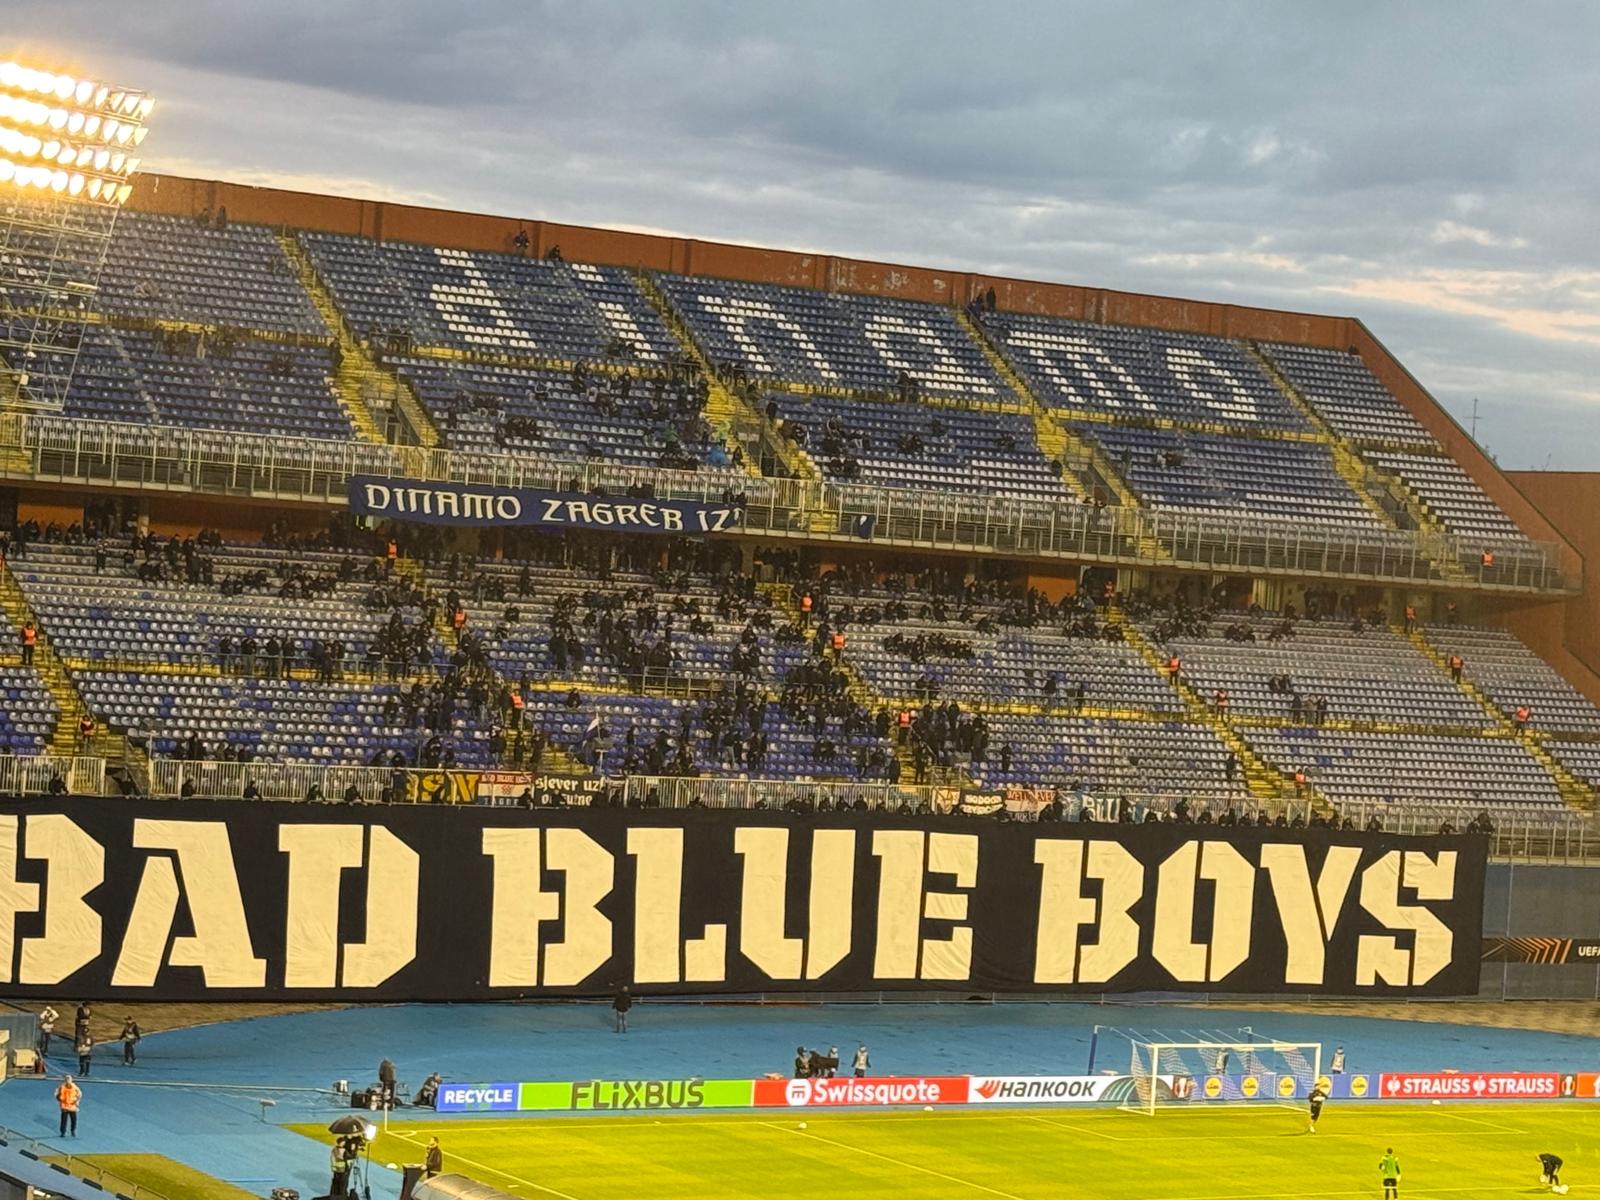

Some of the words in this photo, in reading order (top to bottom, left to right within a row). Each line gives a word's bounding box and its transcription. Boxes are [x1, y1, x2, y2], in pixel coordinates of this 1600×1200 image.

[364, 483, 522, 520] DINAMO
[541, 499, 684, 531] ZAGREB
[535, 775, 579, 791] sjever
[0, 813, 420, 988] BAD
[482, 826, 979, 987] BLUE
[1034, 838, 1457, 987] BOYS
[444, 1089, 513, 1104] RECYCLE
[814, 1078, 941, 1105] Swissquote
[1403, 1078, 1471, 1094] STRAUSS
[1487, 1077, 1554, 1094] STRAUSS
